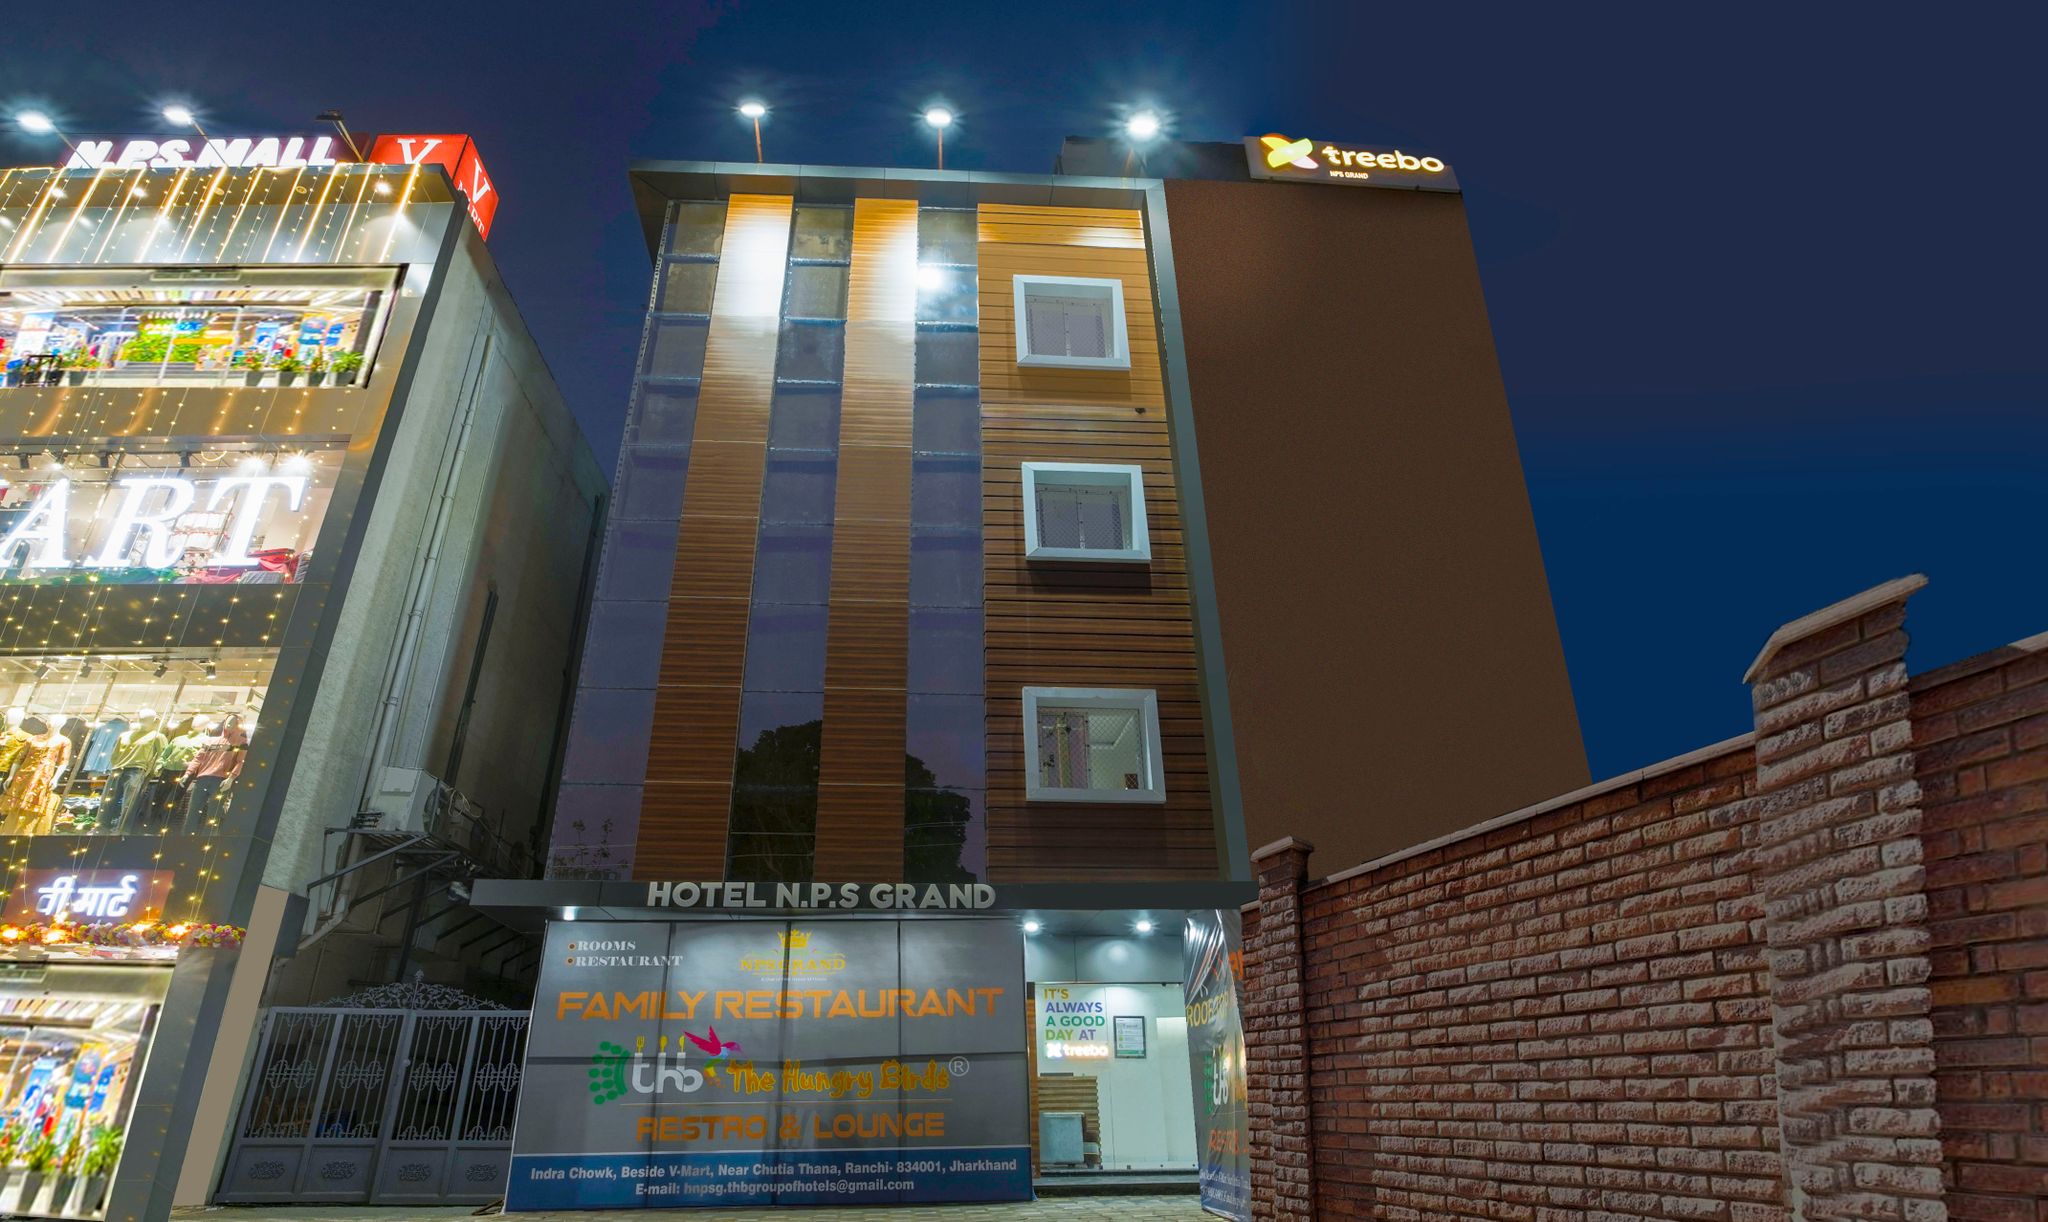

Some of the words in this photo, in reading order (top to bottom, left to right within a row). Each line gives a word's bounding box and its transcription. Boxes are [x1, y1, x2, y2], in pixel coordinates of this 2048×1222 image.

[194, 137, 336, 168] MALL
[1321, 145, 1445, 172] treebo
[1344, 171, 1369, 180] GRAND
[648, 882, 766, 908] HOTEL
[775, 883, 860, 909] N.P.S
[870, 884, 997, 910] GRAND
[578, 941, 636, 951] ROOMS
[575, 955, 683, 967] RESTAURANT
[741, 959, 775, 970] NPS
[1044, 988, 1069, 1000] IT'S
[556, 991, 707, 1021] FAMILY
[714, 987, 1005, 1020] RESTAURANT
[1045, 1002, 1103, 1013] ALWAYS
[1046, 1015, 1056, 1027] A
[1060, 1015, 1105, 1027] GOOD
[1045, 1029, 1074, 1041] DAY
[1078, 1029, 1097, 1041] AT
[1063, 1043, 1109, 1056] treebo
[632, 1051, 704, 1094] thb
[726, 1060, 775, 1092] The
[782, 1058, 874, 1098] Hungry
[879, 1058, 950, 1092] Birds
[636, 1114, 767, 1142] RESTRO
[779, 1114, 801, 1140] &
[813, 1112, 945, 1139] LOUNGE
[531, 1167, 565, 1180] Indra
[569, 1167, 617, 1181] Chowk,
[621, 1165, 665, 1178] Beside
[669, 1164, 714, 1178] V-Mart,
[718, 1163, 749, 1176] Near
[752, 1162, 794, 1175] Chutia
[798, 1162, 841, 1176] Thana,
[896, 1161, 946, 1174] 834001,
[950, 1159, 1017, 1171] Jharkhand
[635, 1182, 680, 1195] E-mail:
[684, 1179, 915, 1197] hnpsg.thbgroupofhotels@gmail.com
